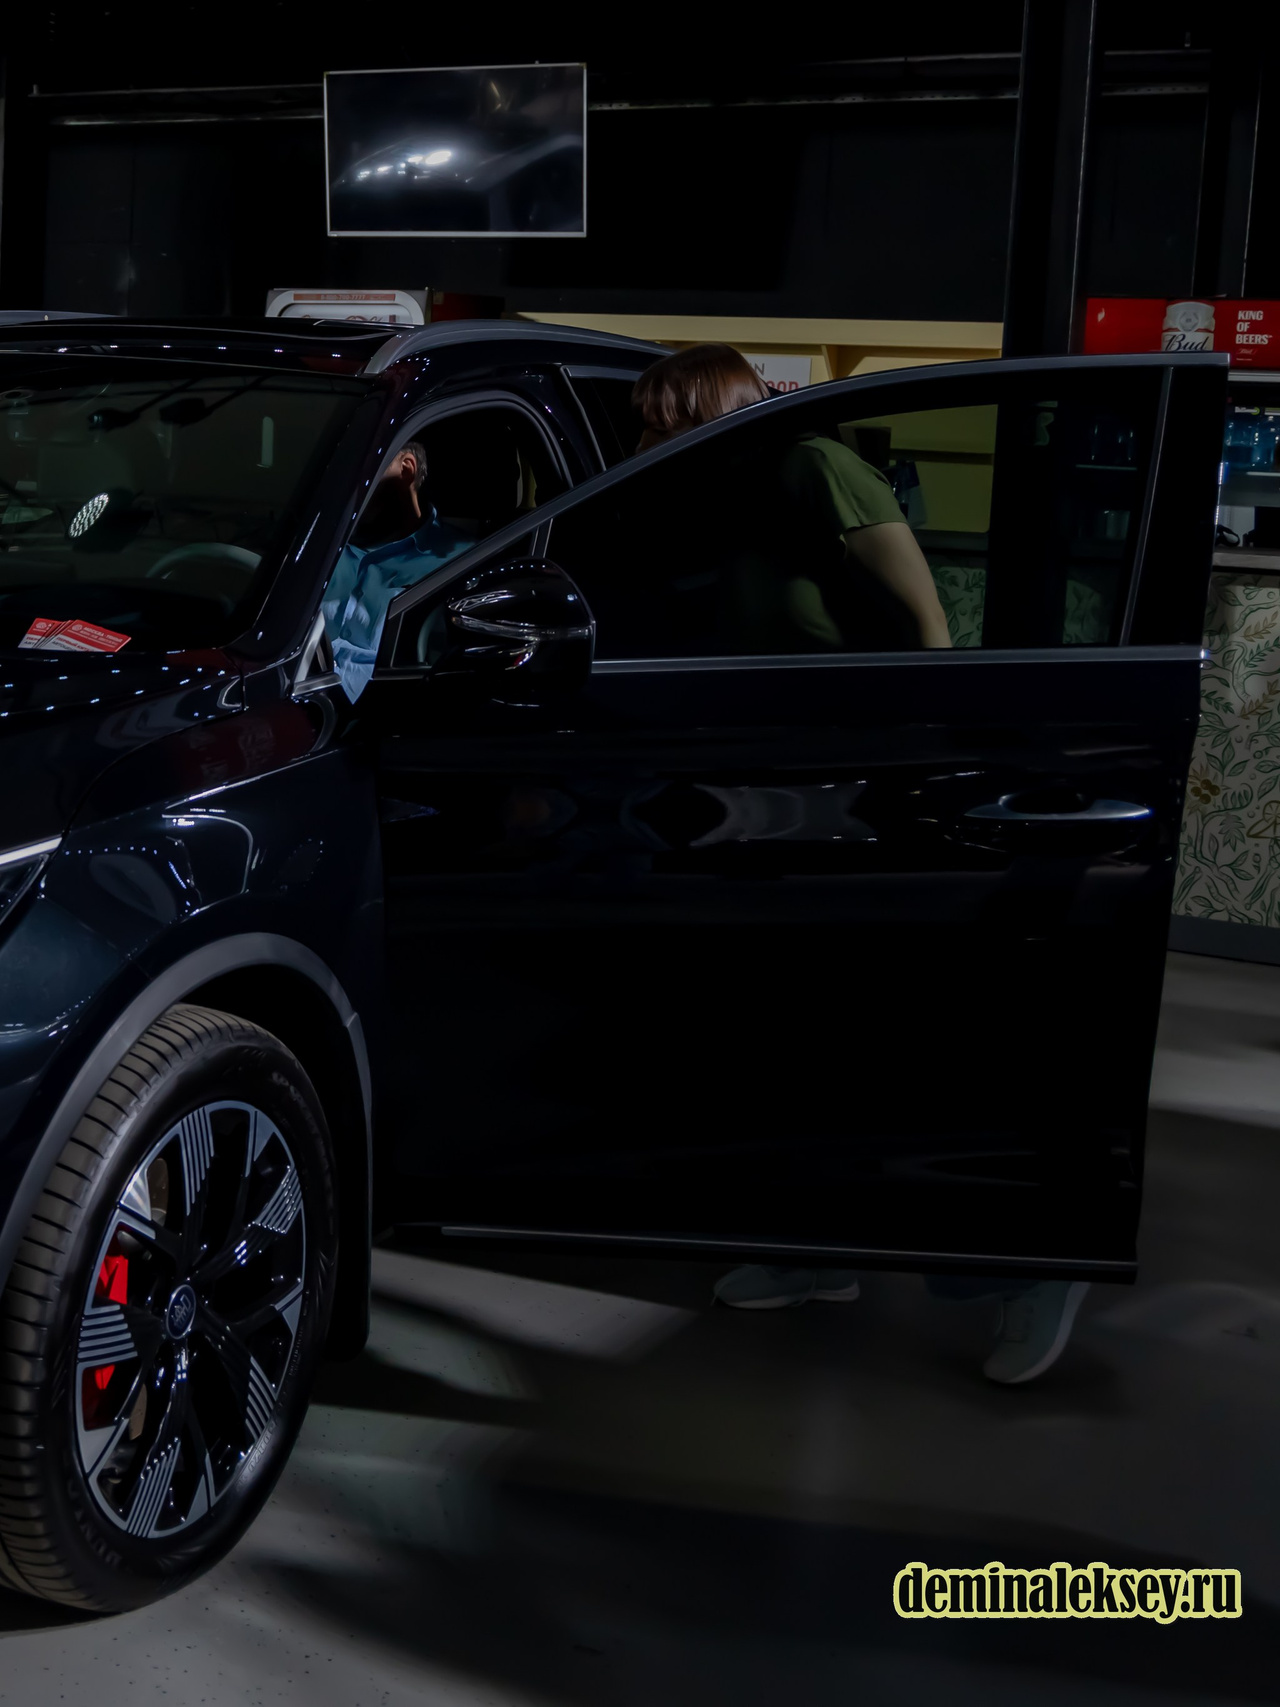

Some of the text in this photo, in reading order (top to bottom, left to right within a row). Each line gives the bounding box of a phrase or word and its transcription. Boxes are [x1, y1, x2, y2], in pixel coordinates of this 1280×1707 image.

[1238, 310, 1264, 321] KING
[1236, 321, 1251, 332] OF
[1163, 333, 1209, 351] Bud
[1235, 333, 1269, 345] BEERS
